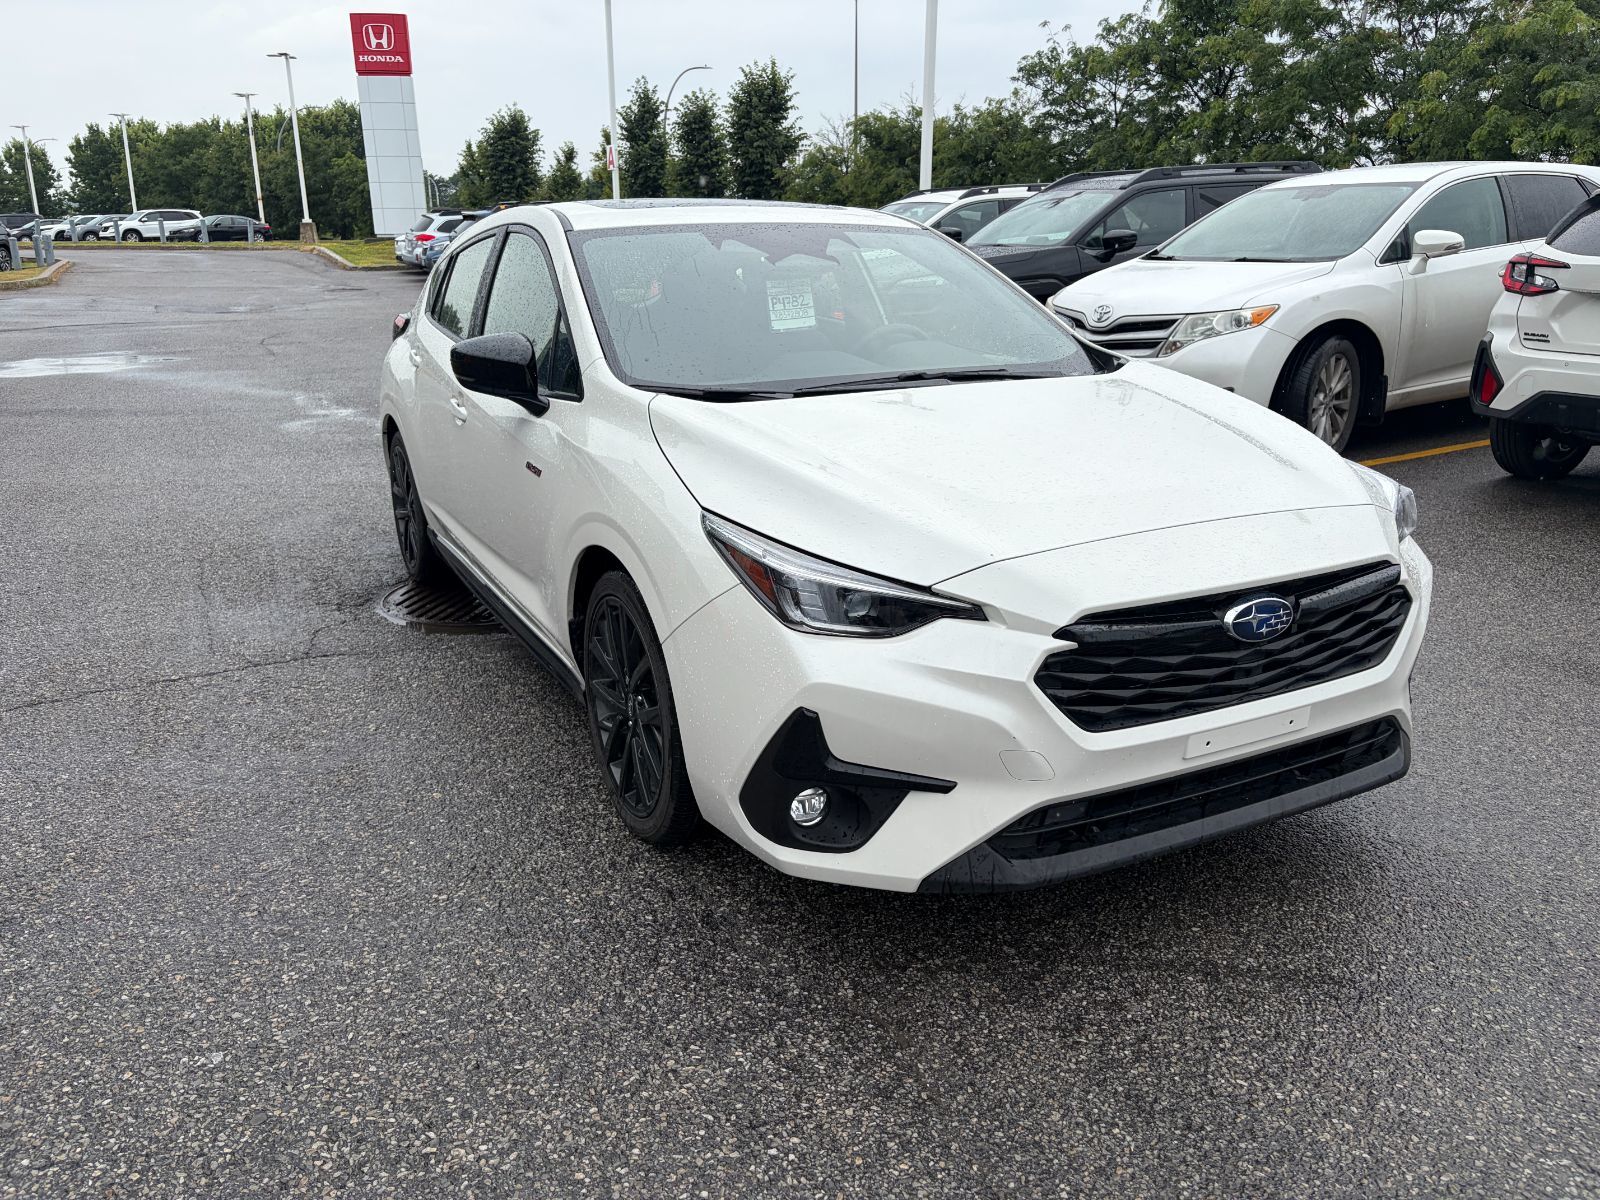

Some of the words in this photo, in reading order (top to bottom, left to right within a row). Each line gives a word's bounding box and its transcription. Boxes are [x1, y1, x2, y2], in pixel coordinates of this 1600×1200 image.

[358, 55, 405, 63] HONDA
[771, 294, 809, 310] P4782
[1523, 331, 1549, 339] SUBARU
